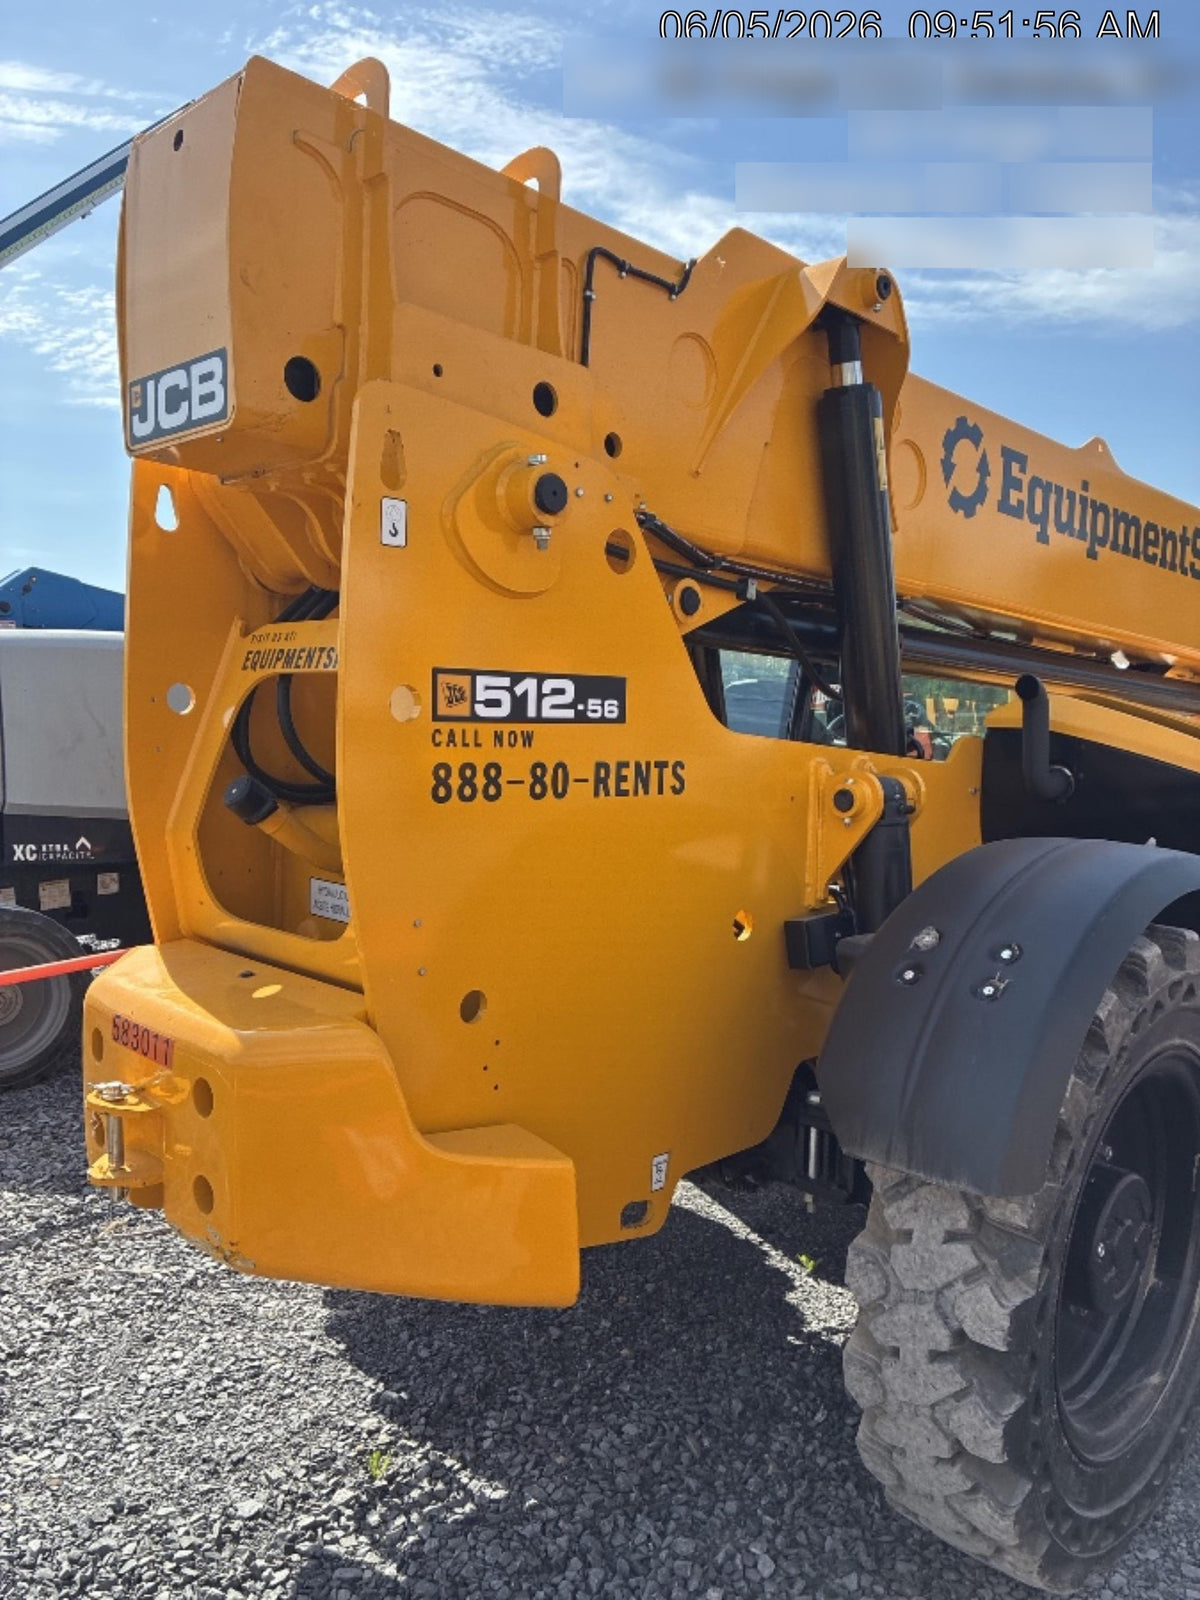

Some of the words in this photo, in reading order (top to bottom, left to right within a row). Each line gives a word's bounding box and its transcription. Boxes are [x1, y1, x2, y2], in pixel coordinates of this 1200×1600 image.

[132, 356, 225, 438] JCB
[241, 646, 338, 672] EQUIPMENTS
[431, 728, 482, 748] CALL
[493, 730, 535, 749] NOW
[431, 760, 686, 804] 888-80-RENTS
[12, 843, 37, 861] XC
